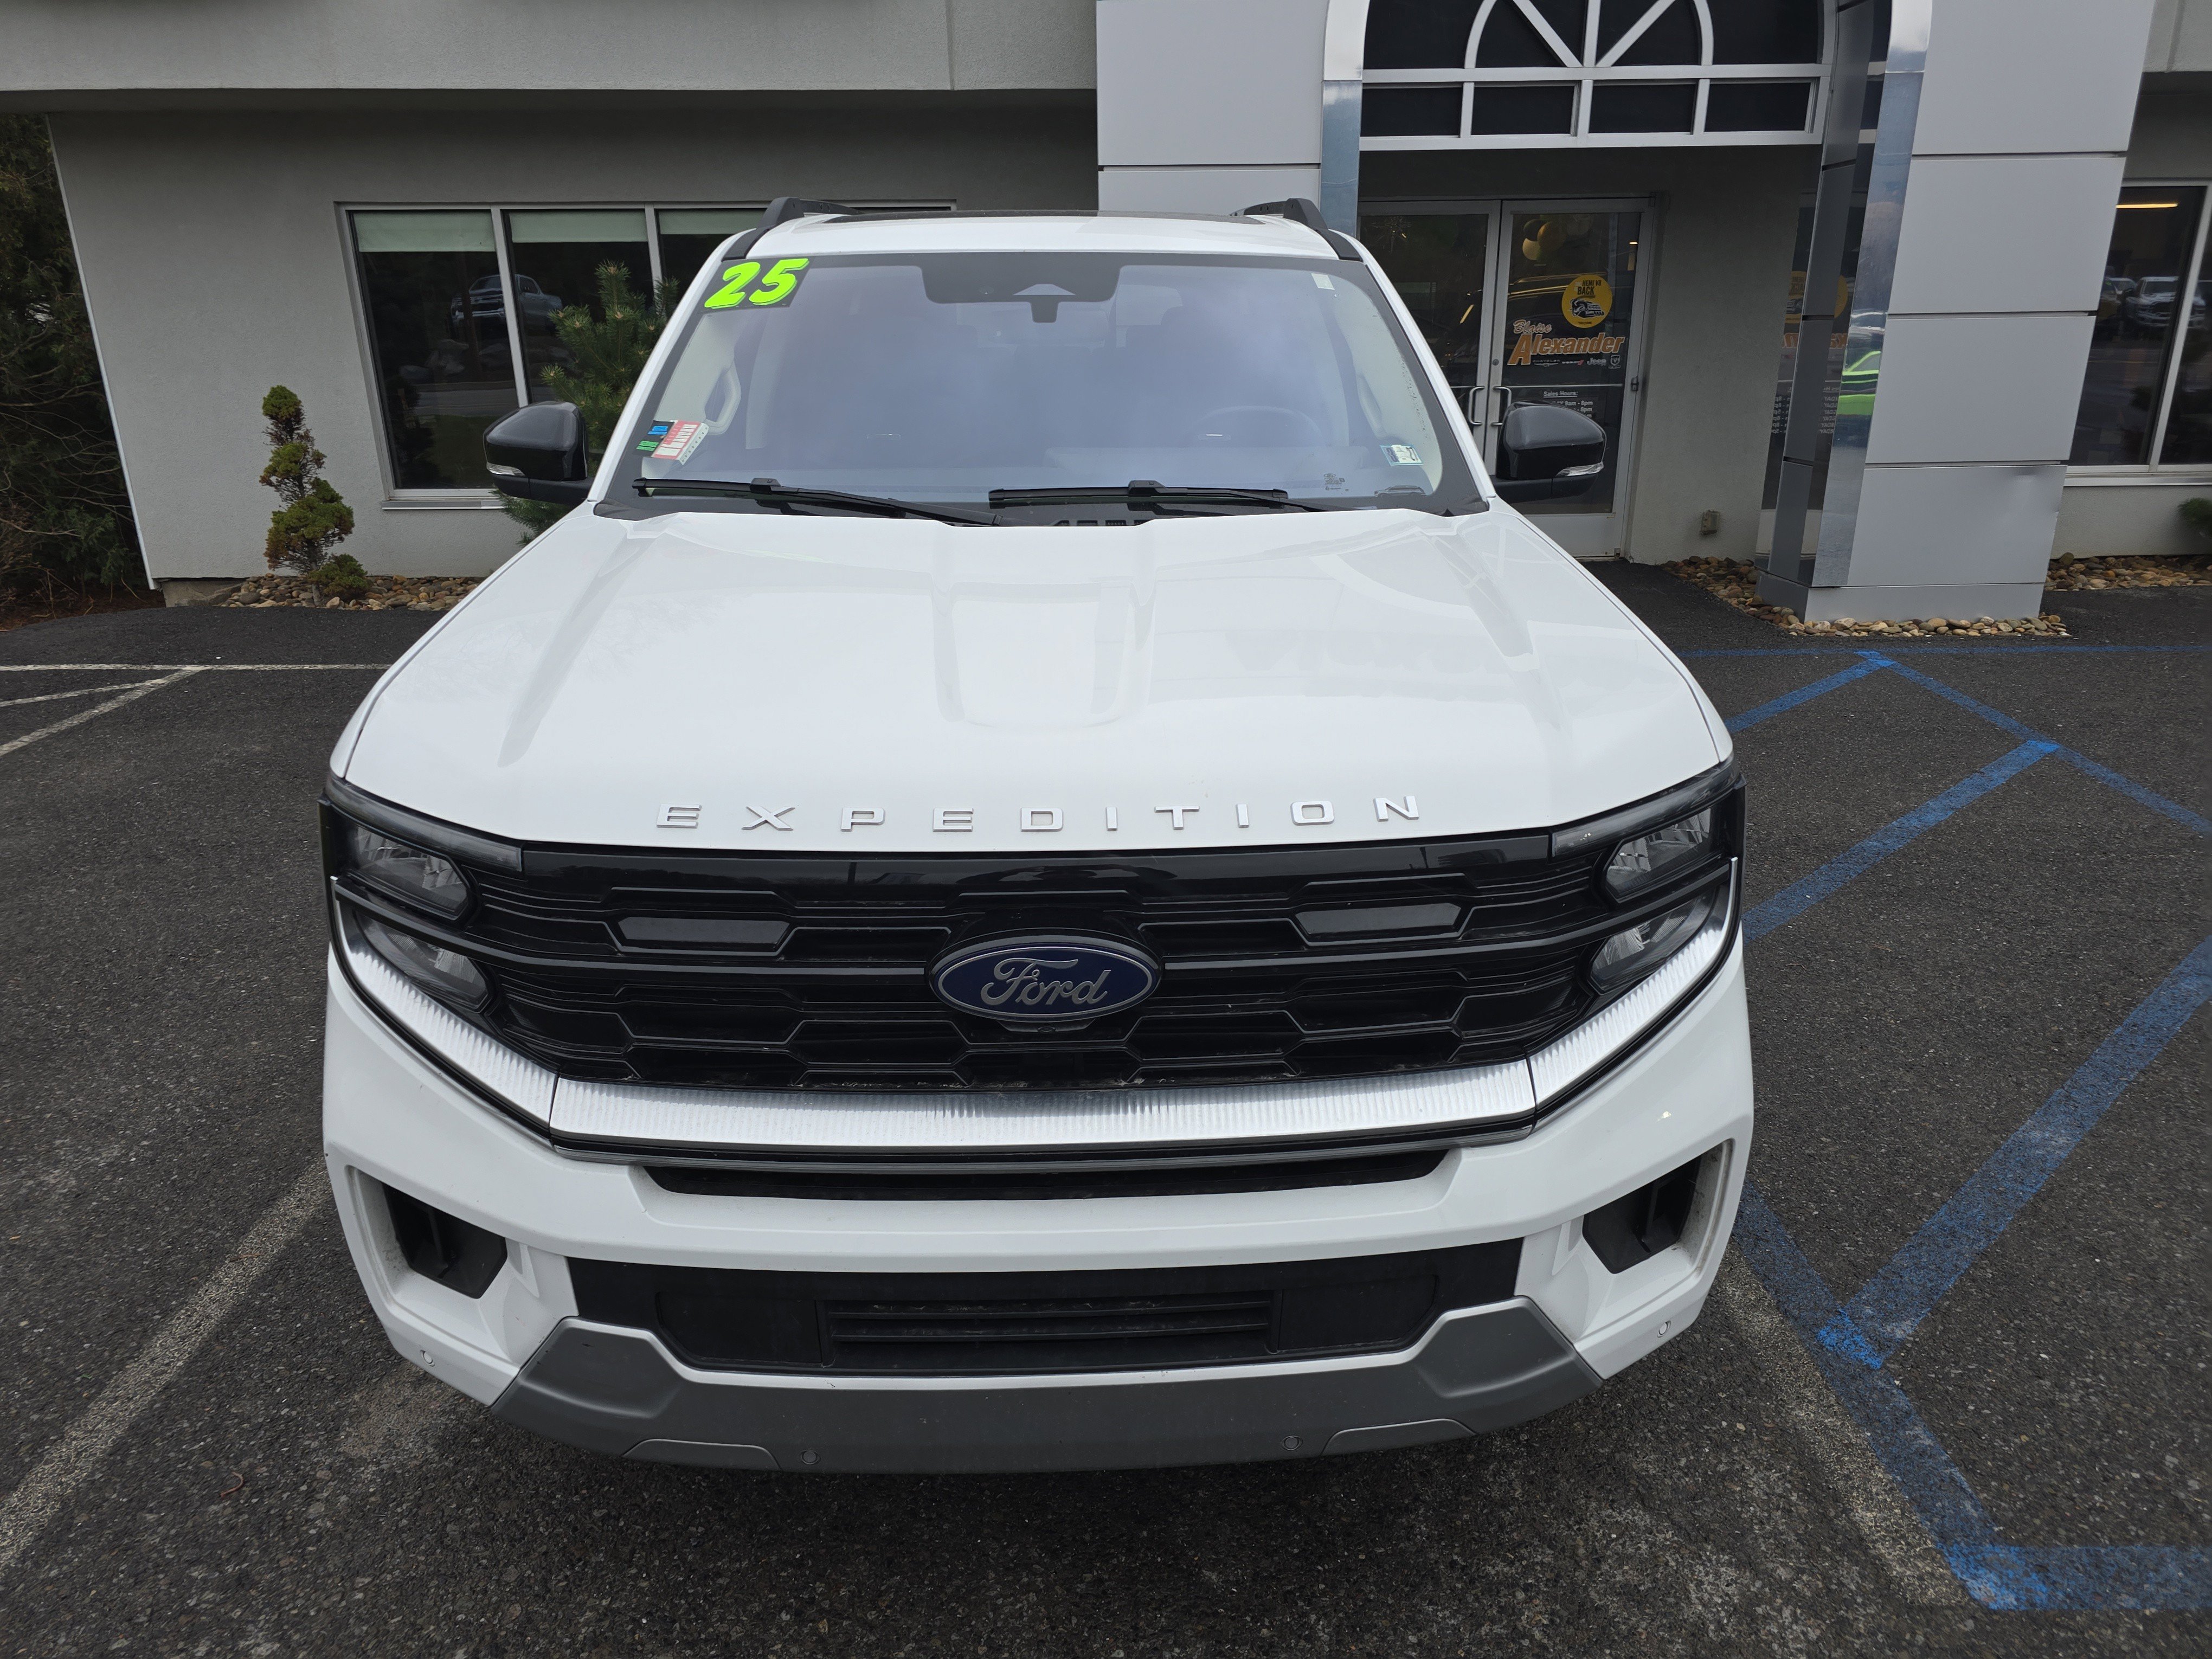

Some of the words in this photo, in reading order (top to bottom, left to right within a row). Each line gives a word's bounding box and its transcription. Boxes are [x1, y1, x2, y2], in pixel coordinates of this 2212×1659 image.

[704, 258, 809, 310] 25
[1577, 286, 1595, 295] BACK
[1513, 319, 1552, 334] Blaise
[1507, 332, 1626, 365] Alexander
[1586, 357, 1607, 365] Jeep
[656, 795, 1420, 832] EXPEDITION
[980, 957, 1112, 1006] Ford
